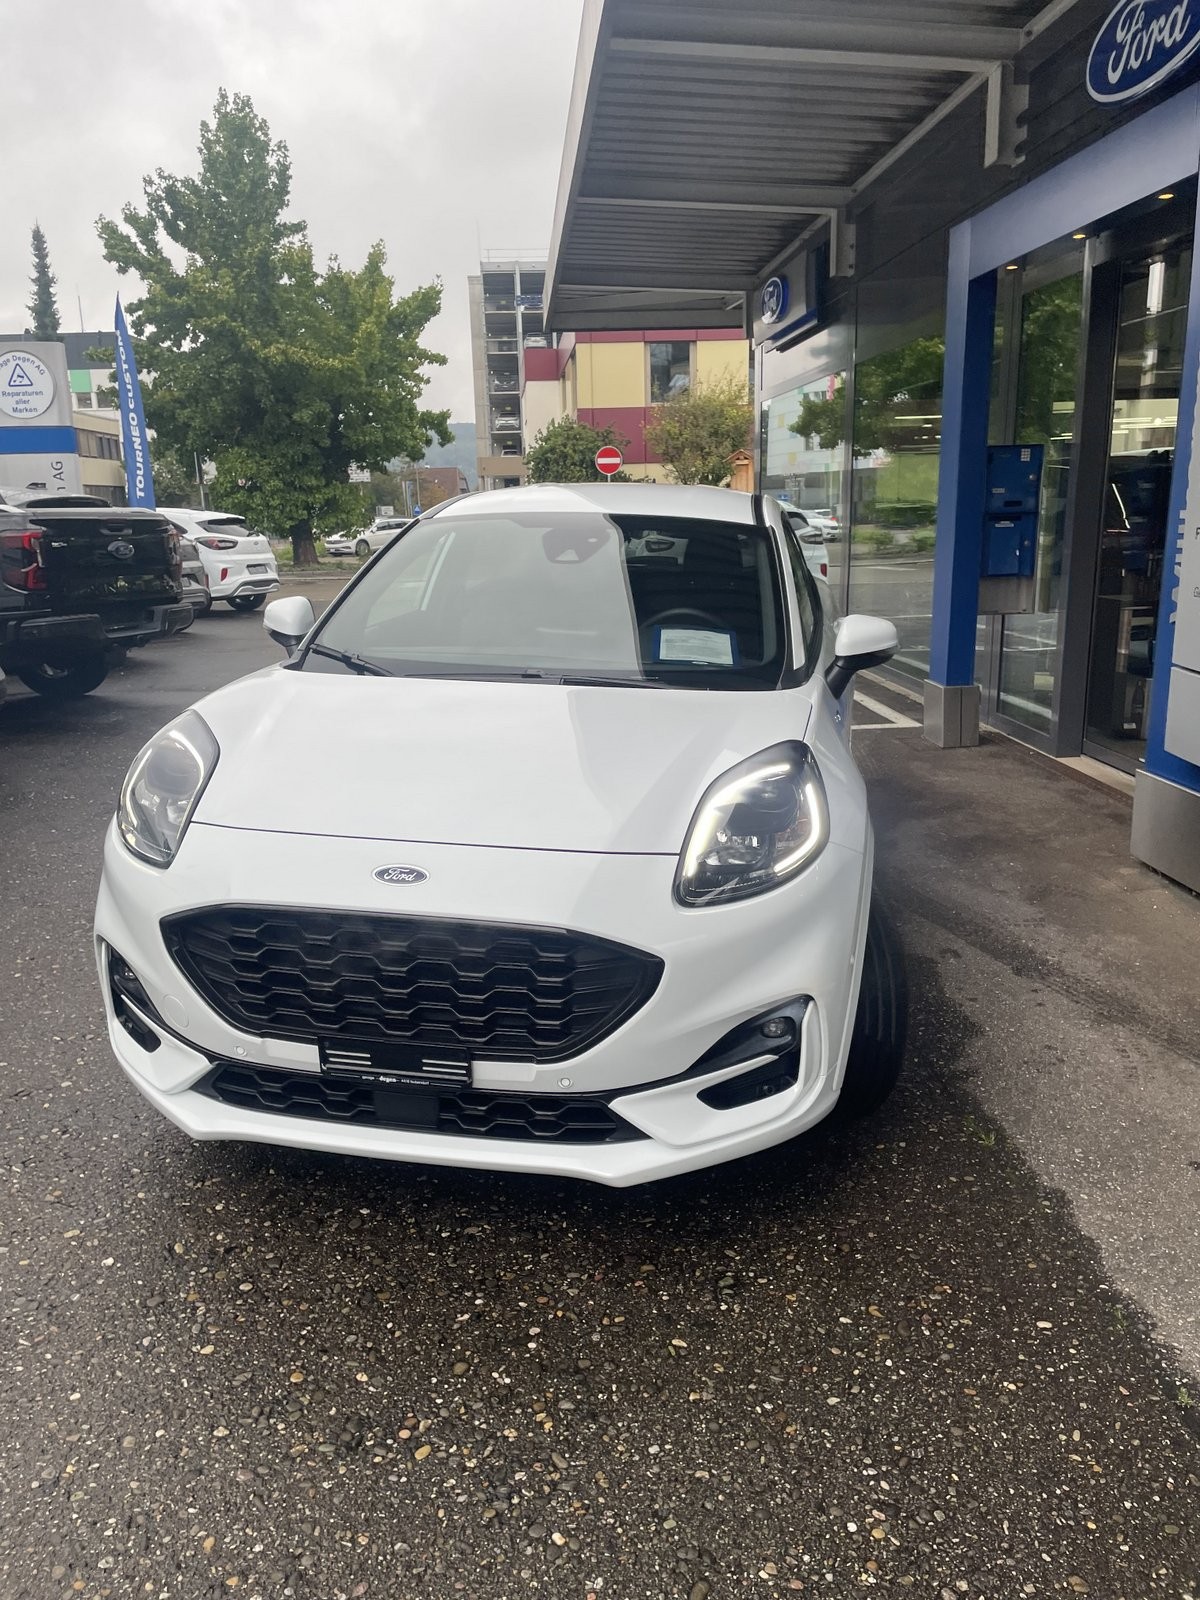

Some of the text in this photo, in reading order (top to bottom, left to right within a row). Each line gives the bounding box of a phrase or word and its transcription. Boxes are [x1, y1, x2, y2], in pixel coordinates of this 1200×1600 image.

[1107, 0, 1191, 84] Ford
[12, 355, 36, 366] Degen
[35, 364, 46, 375] AG
[2, 390, 44, 398] Reparaturen
[115, 329, 145, 499] TOURNEO CUSTOM
[51, 460, 65, 482] AG
[383, 867, 417, 881] Ford
